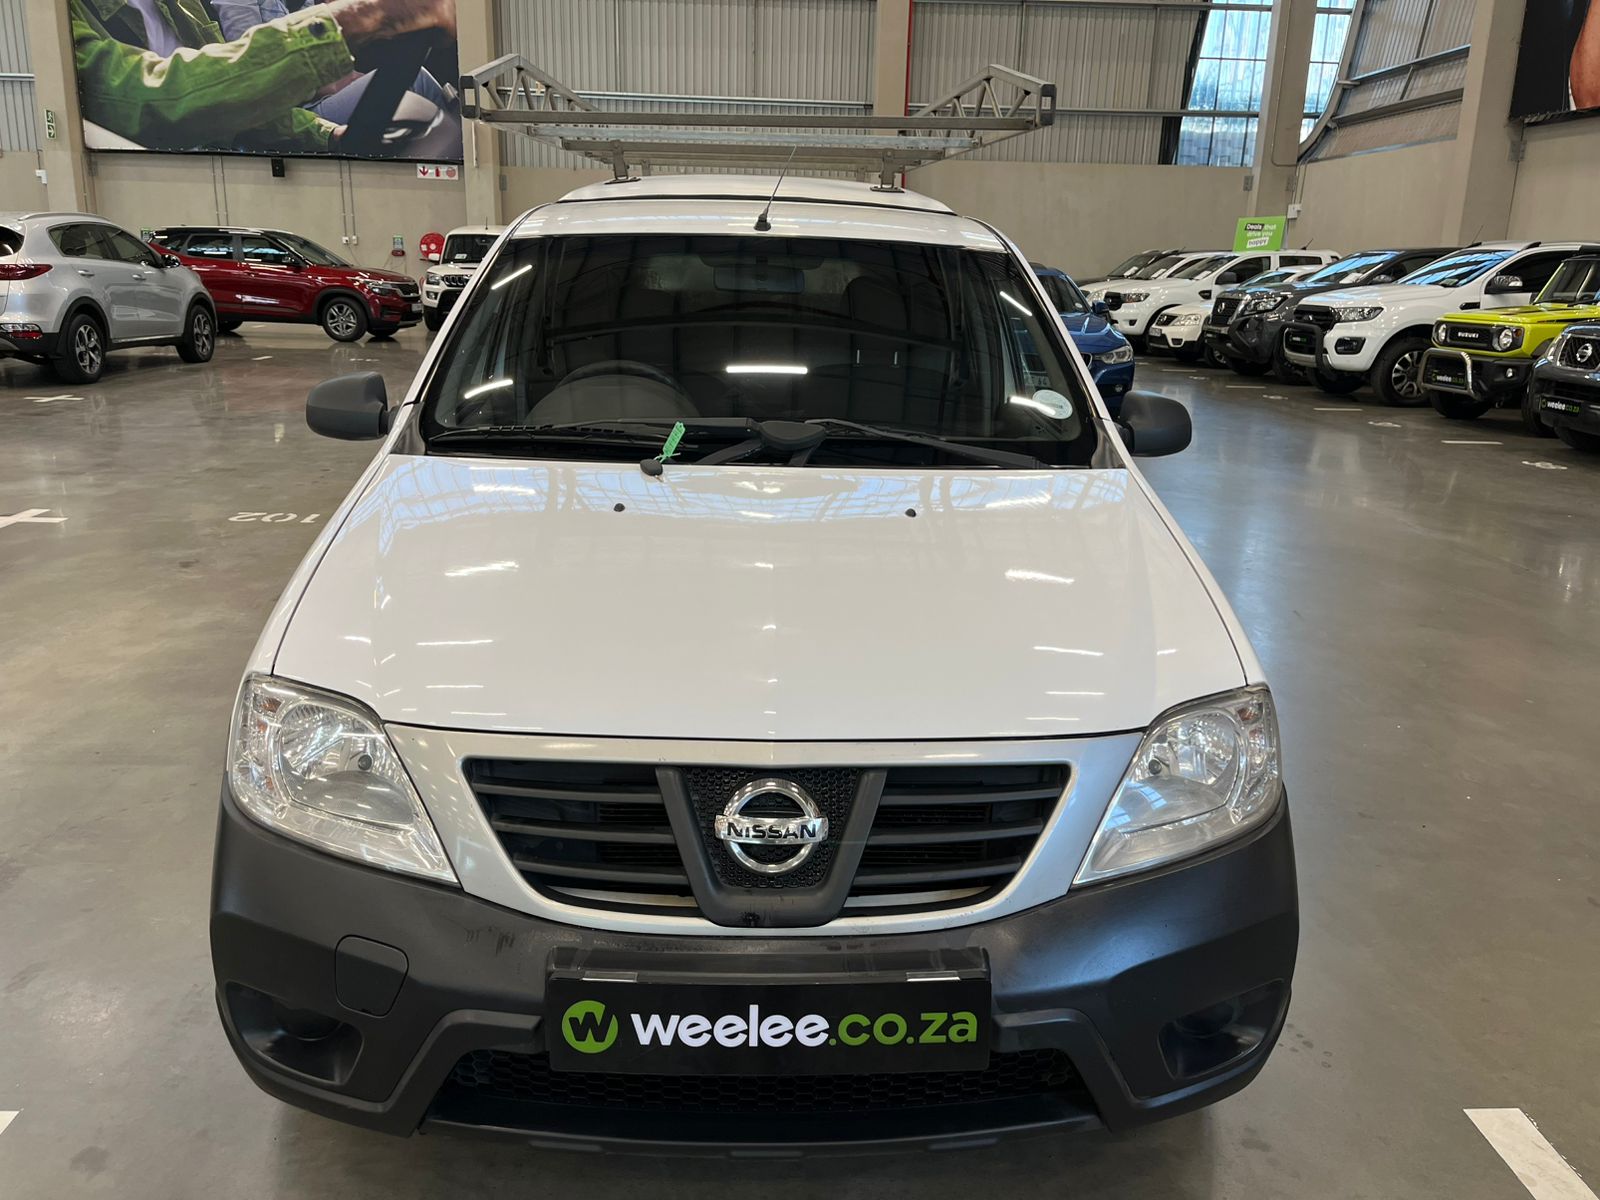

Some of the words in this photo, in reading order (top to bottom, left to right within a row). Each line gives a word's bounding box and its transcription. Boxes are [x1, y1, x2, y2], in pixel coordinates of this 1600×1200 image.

[1248, 238, 1267, 246] happy
[727, 821, 816, 839] NISSAN
[630, 1004, 978, 1048] weelee.co.za
